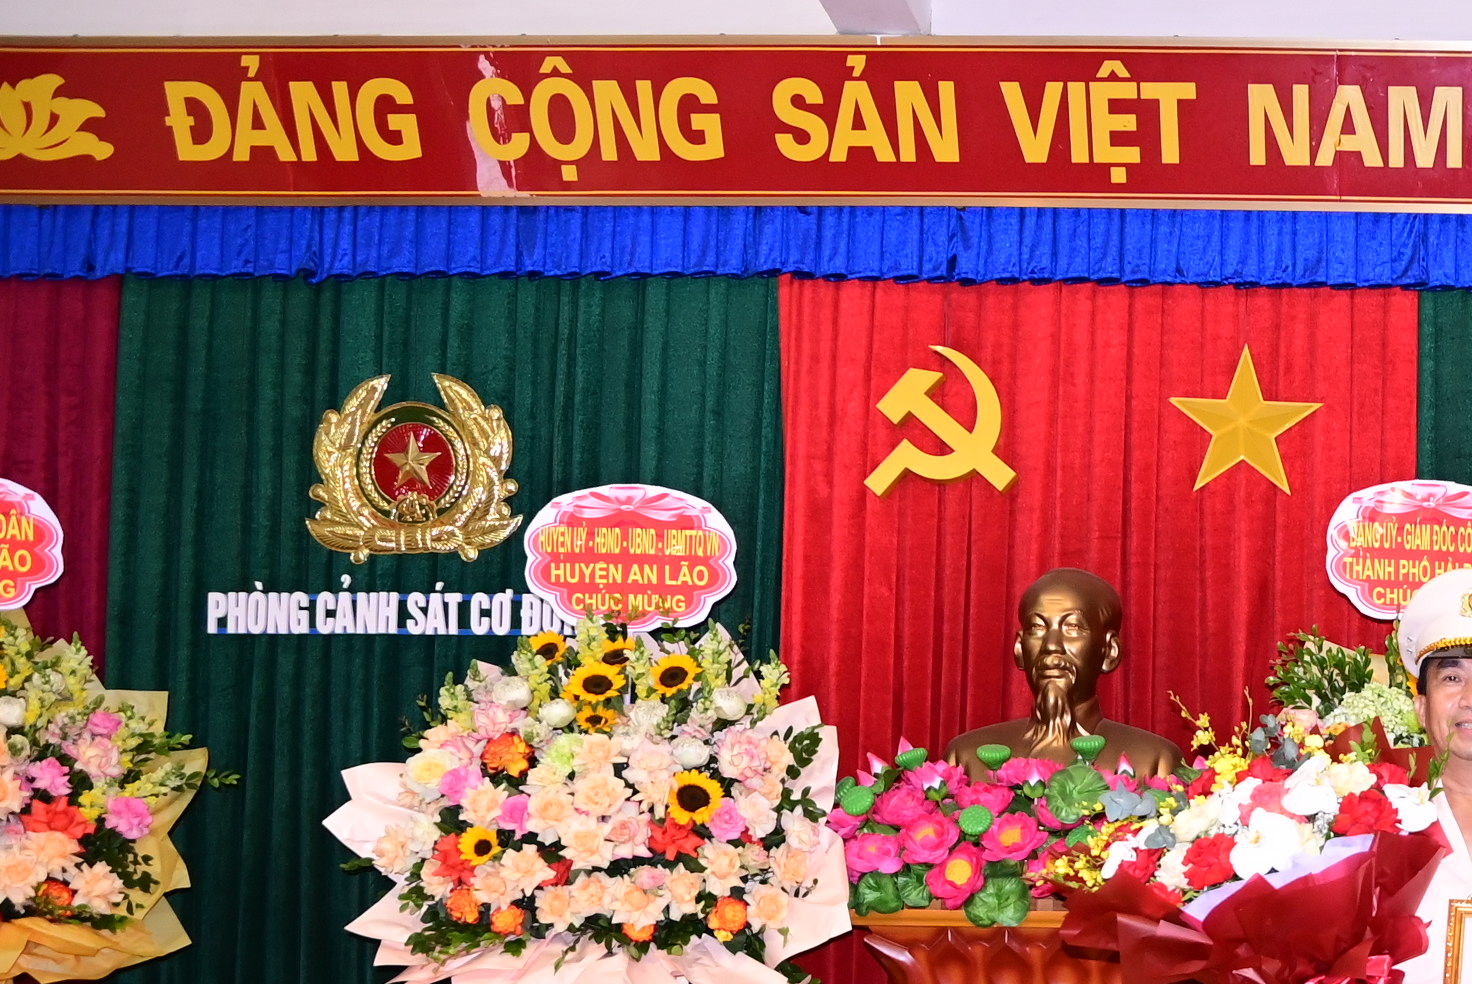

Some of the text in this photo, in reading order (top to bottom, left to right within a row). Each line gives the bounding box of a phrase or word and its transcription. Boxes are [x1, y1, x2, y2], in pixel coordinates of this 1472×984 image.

[164, 54, 423, 162] ĐẢNG
[469, 56, 725, 181] CỘNG
[773, 54, 961, 163] SẢN
[1000, 60, 1197, 183] VIỆT
[1249, 83, 1463, 168] NAM
[540, 524, 571, 560] HUYỆN
[594, 527, 621, 553] HĐND
[629, 528, 656, 554] UBND
[706, 530, 719, 556] VN
[1403, 517, 1431, 551] GIÁM
[1432, 519, 1456, 552] ĐỐC
[0, 544, 32, 572] ÃO
[1343, 553, 1395, 581] THÀNH
[1399, 555, 1431, 582] PHỐ
[550, 561, 709, 588] HUYỆN AN LÃO
[207, 580, 310, 635] PHÒNG
[315, 573, 399, 635] CẢNH
[406, 581, 463, 635] SÁT
[470, 588, 514, 636] CƠ
[571, 589, 623, 611] CHÚC
[1372, 584, 1420, 606] CHÚ
